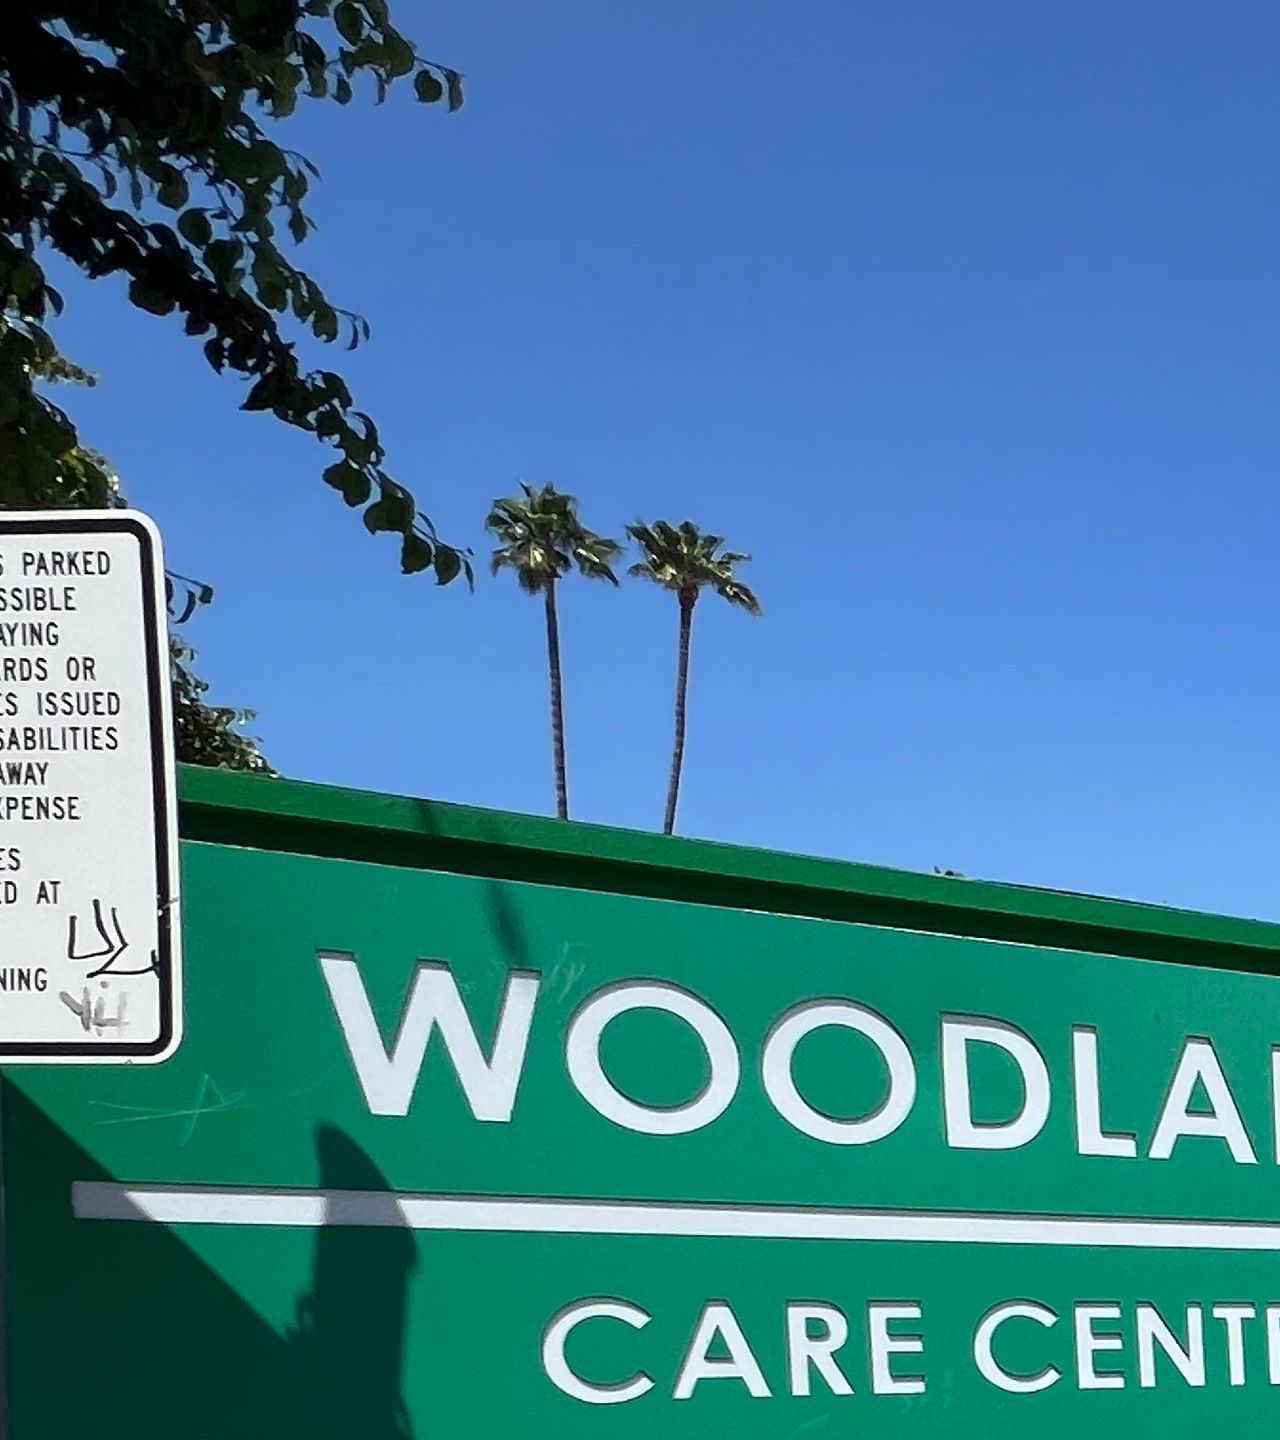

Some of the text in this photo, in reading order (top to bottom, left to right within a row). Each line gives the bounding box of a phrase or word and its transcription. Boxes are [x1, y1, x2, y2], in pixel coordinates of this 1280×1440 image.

[22, 551, 110, 576] PARKED
[0, 656, 96, 682] RDS OR
[36, 691, 120, 716] ISSUED
[36, 880, 61, 905] AT
[541, 1296, 926, 1404] CARE
